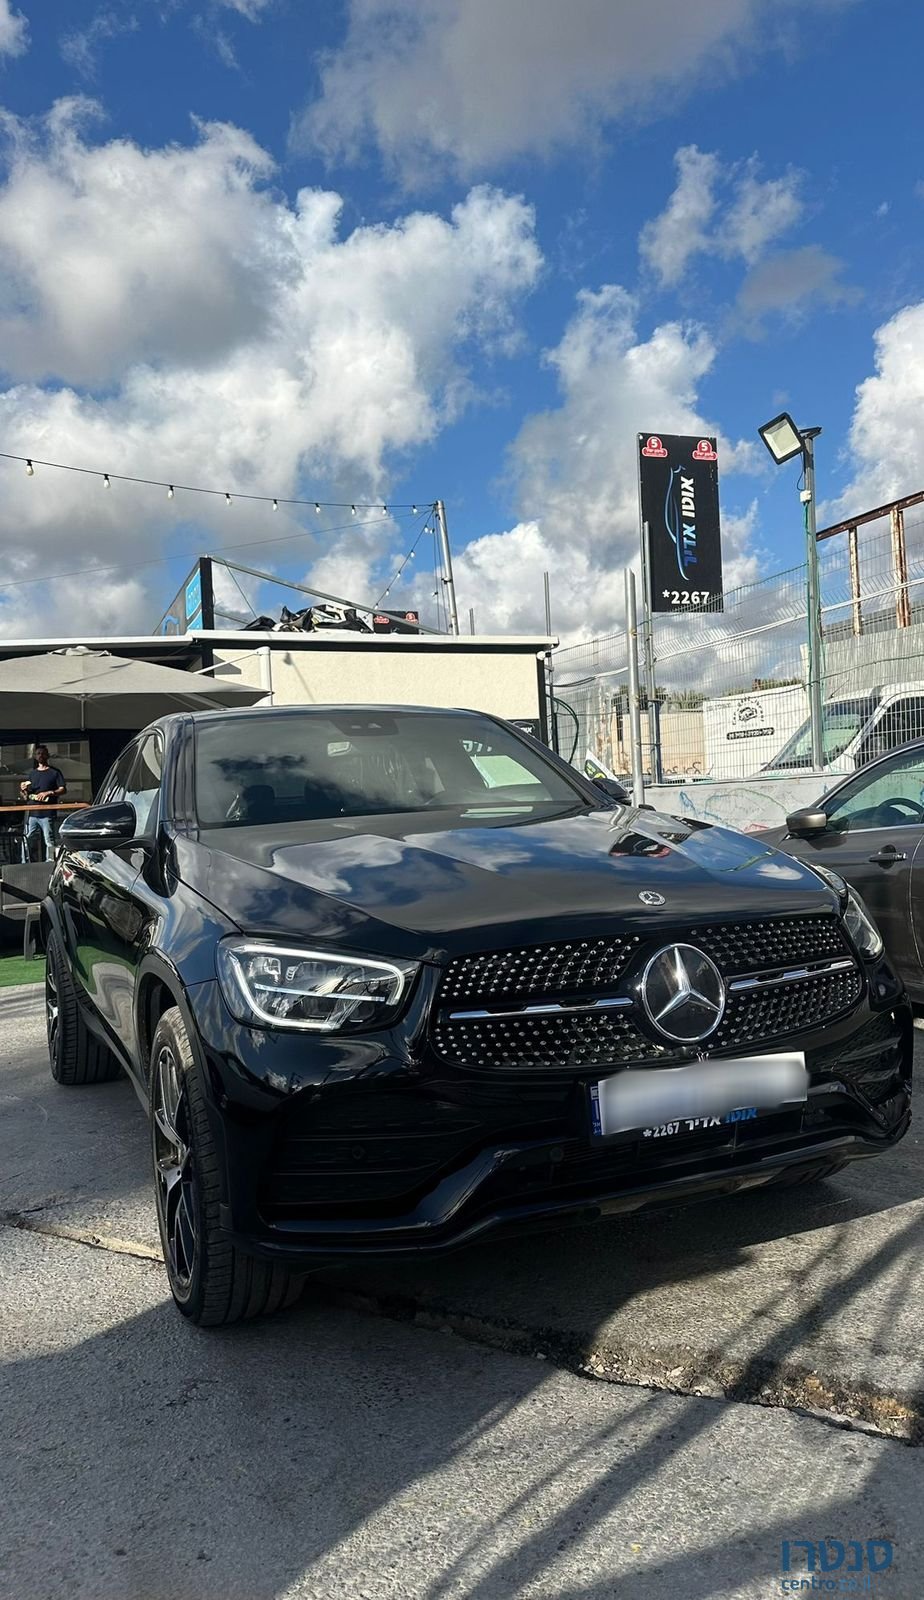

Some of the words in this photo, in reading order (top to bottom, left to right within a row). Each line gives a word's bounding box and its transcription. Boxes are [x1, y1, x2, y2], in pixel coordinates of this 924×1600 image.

[651, 439, 659, 448] 5
[701, 442, 709, 451] 5
[681, 476, 696, 518] אוטו
[683, 523, 697, 566] אדיר
[685, 1116, 721, 1130] אדיר
